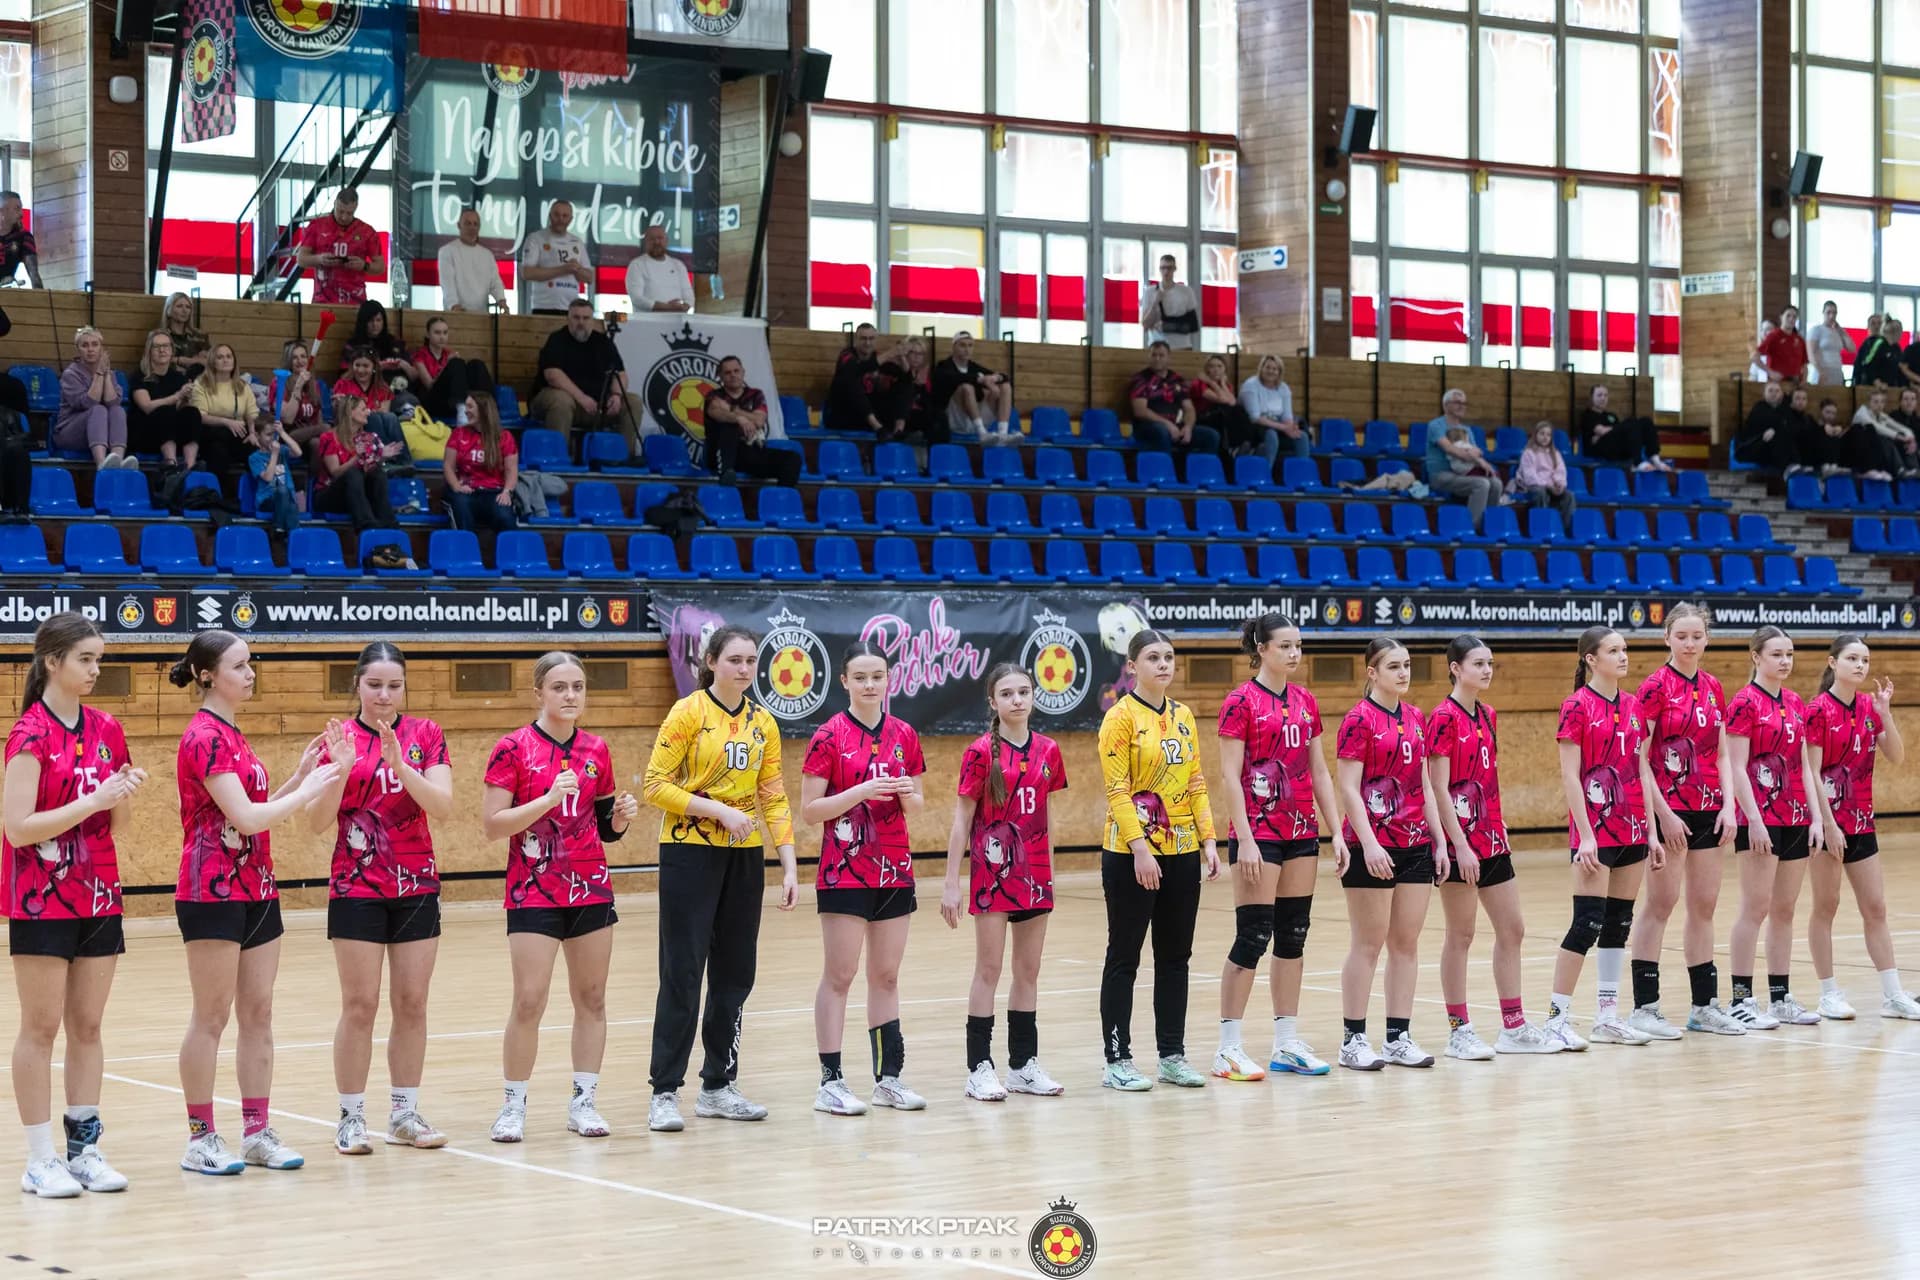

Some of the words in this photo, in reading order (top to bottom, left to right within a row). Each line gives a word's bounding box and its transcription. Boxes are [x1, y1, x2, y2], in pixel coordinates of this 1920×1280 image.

[254, 3, 296, 48] KORONA
[441, 96, 591, 188] Najlepsi
[600, 109, 707, 175] kibice
[411, 169, 473, 235] to
[475, 192, 527, 255] my
[332, 242, 348, 257] 10
[557, 249, 569, 263] 12
[1241, 259, 1255, 271] C
[659, 357, 720, 384] KORON
[470, 449, 485, 463] 19
[0, 596, 107, 623] dballpl
[266, 596, 569, 630] www.koronahandball.pl
[1420, 599, 1624, 627] www.koronahandball.pl
[1715, 603, 1896, 629] www.koronahandball.pl
[769, 632, 814, 653] KORONA
[859, 596, 961, 663] Pink
[1034, 630, 1076, 650] KORONA
[765, 690, 821, 714] HANDBALL
[1033, 685, 1081, 709] HANDBALL
[1695, 706, 1707, 728] 6
[1281, 723, 1300, 749] 10
[1616, 731, 1626, 756] 7
[1785, 722, 1795, 744] 5
[1852, 733, 1862, 754] 4
[723, 741, 749, 771] 16
[1160, 739, 1183, 765] 12
[1402, 740, 1413, 765] 9
[1480, 745, 1490, 770] 8
[74, 767, 101, 799] 25
[250, 763, 267, 791] 20
[375, 766, 403, 794] 19
[1016, 786, 1036, 814] 13
